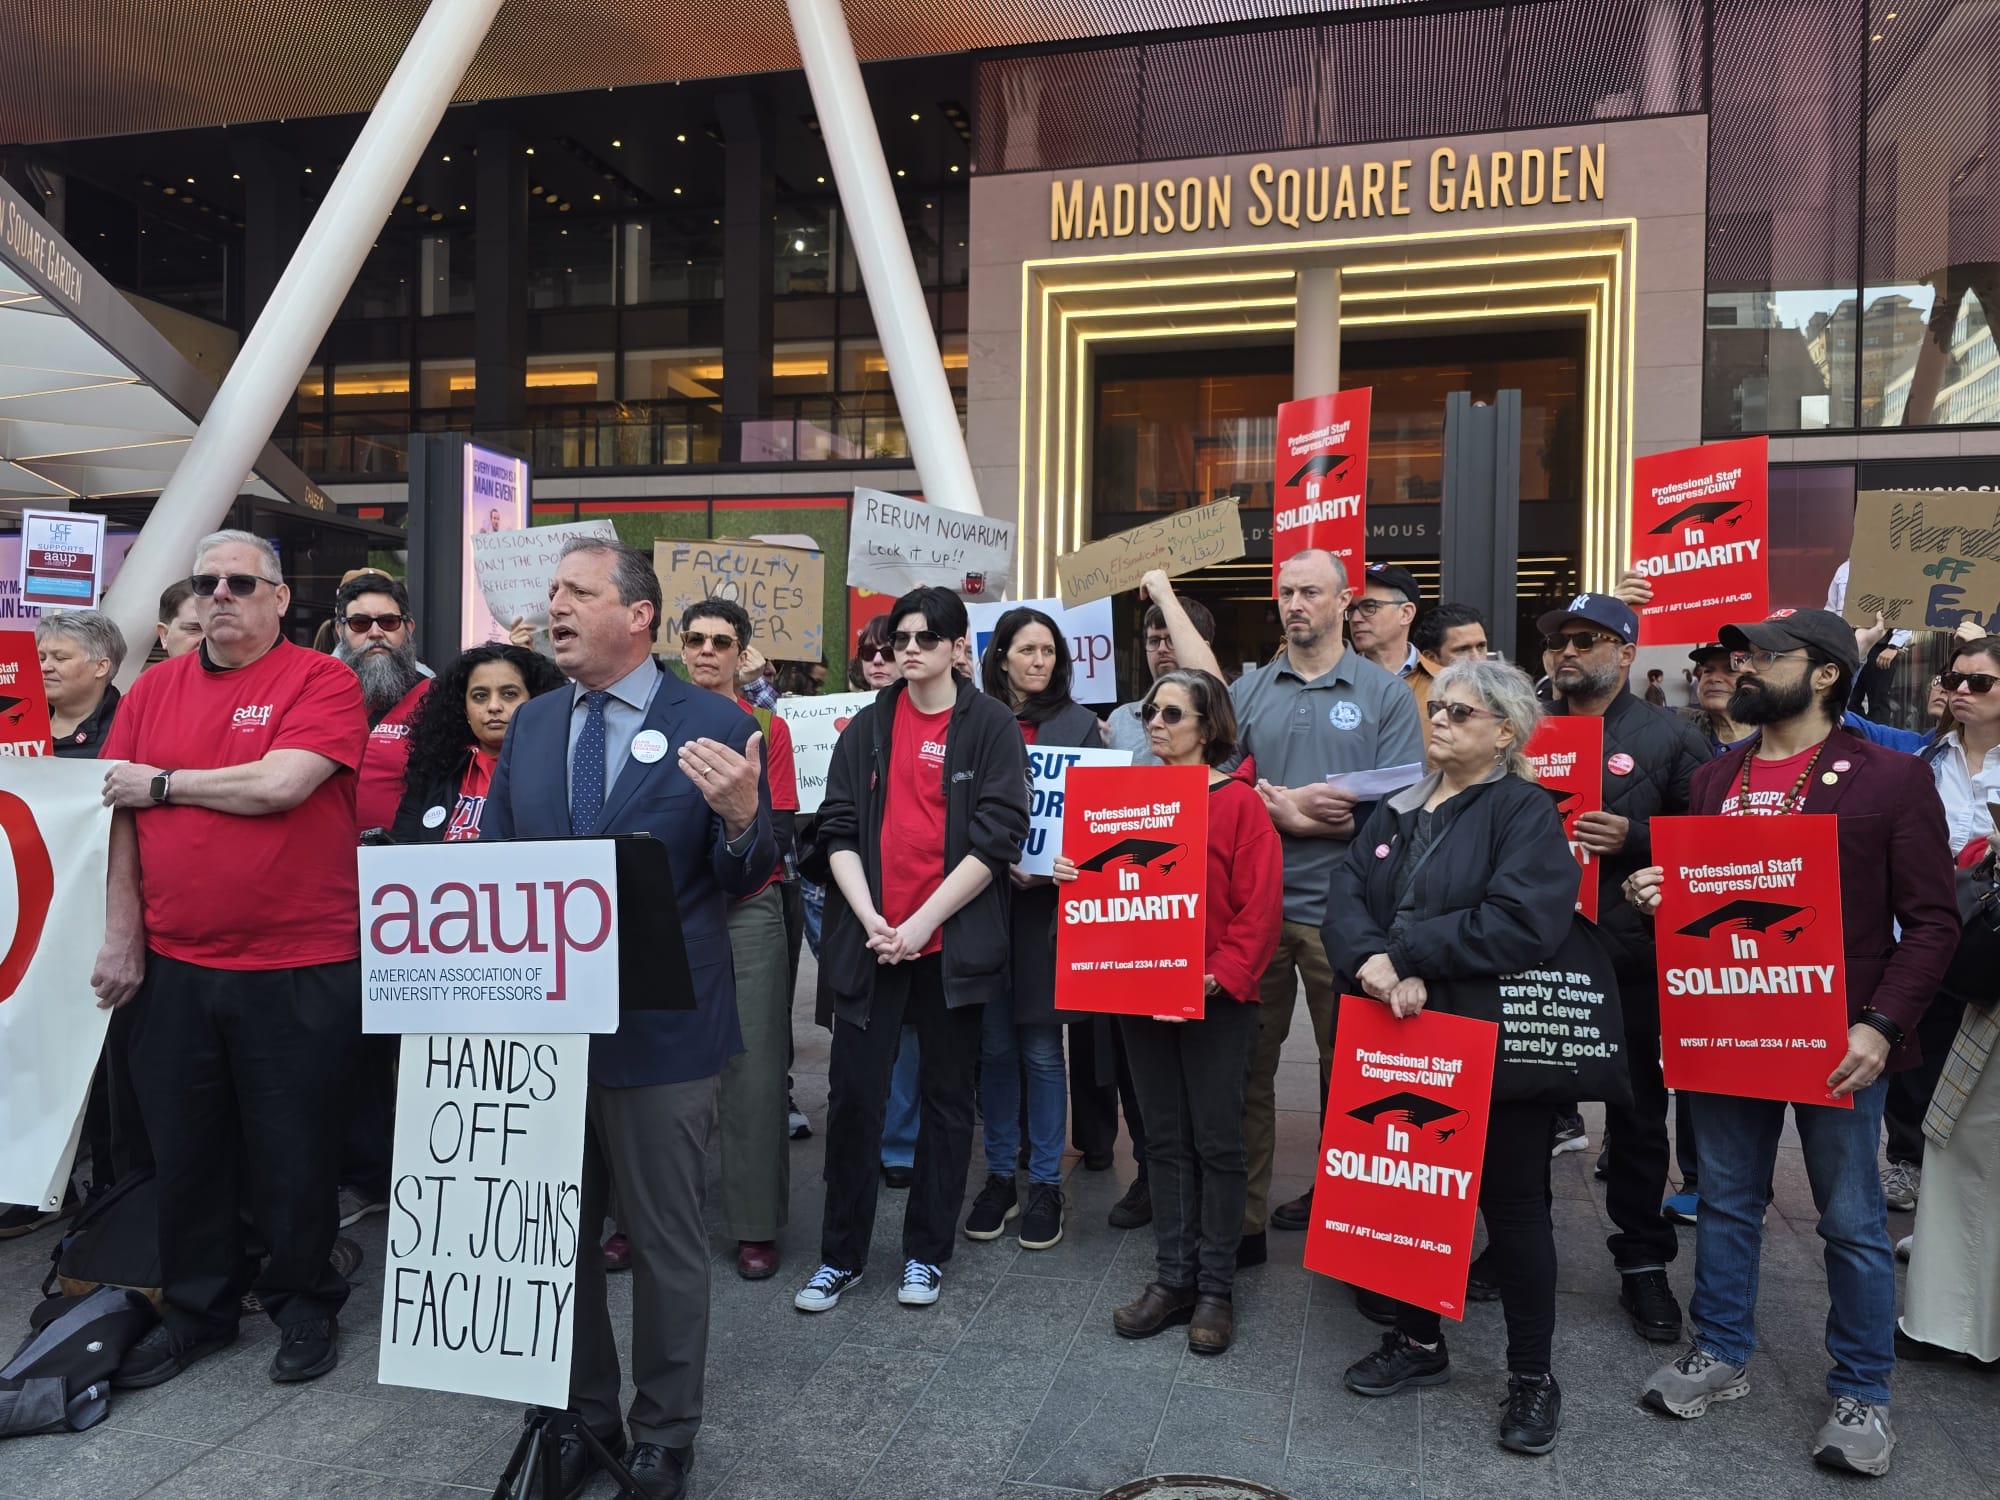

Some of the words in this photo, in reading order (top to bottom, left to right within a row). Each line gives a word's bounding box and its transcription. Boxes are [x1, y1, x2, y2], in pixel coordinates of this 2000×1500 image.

[1288, 423, 1330, 447] Professional
[1331, 420, 1350, 434] Staff
[1291, 432, 1346, 457] Congress/CUNY
[474, 475, 494, 497] MAIN
[495, 482, 517, 504] EVENT
[1306, 481, 1320, 500] In
[1652, 474, 1713, 497] Professional
[1715, 468, 1742, 483] Staff
[1657, 480, 1736, 506] Congress/CUNY
[1276, 495, 1361, 532] SOLIDARITY
[49, 523, 72, 533] UCE
[866, 498, 930, 534] RERUM
[937, 518, 1009, 551] NOVARUM
[474, 535, 543, 550] DECISIONS
[1119, 522, 1164, 552] YES
[1684, 527, 1704, 546] In
[38, 544, 84, 552] SUPPORTS
[1635, 538, 1761, 578] SOLIDARITY
[44, 552, 77, 567] aaup
[476, 557, 505, 573] ONLY
[511, 555, 533, 568] THE
[672, 549, 800, 583] FACULTY
[519, 579, 542, 589] THE
[702, 575, 804, 610] VOICES
[521, 603, 545, 613] THE
[784, 705, 837, 720] FACULTY
[793, 744, 808, 753] OF
[921, 740, 947, 757] aau
[1551, 752, 1576, 764] Staff
[1084, 805, 1150, 822] Professional
[1153, 802, 1180, 815] Staff
[1090, 816, 1175, 834] Congress/CUNY
[1680, 861, 1764, 879] Professional
[1767, 858, 1803, 873] Staff
[1118, 868, 1139, 891] In
[1688, 873, 1796, 894] Congress/CUNY
[1065, 894, 1199, 925] SOLIDARITY
[370, 878, 612, 1001] aaup
[1731, 934, 1758, 959] In
[369, 968, 436, 983] AMERICAN
[439, 967, 522, 982] ASSOCIATION
[525, 967, 542, 981] OF
[1071, 962, 1094, 971] NYSUT
[1100, 961, 1114, 970] AFT
[1115, 960, 1133, 969] Local
[1135, 960, 1153, 969] 2334
[1159, 959, 1187, 968] AFL-CIO
[1566, 972, 1592, 985] are
[1666, 965, 1835, 995] SOLIDARITY
[369, 986, 449, 1001] UNIVERSITY
[453, 986, 543, 1001] PROFESSORS
[1499, 984, 1553, 1001] rarely
[1558, 986, 1605, 1004] clever
[1503, 1001, 1537, 1015] and
[1542, 1002, 1591, 1020] clever
[1504, 1021, 1570, 1036] women
[1574, 1025, 1600, 1039] are
[1504, 1038, 1557, 1056] rarely
[1680, 1038, 1708, 1047] NYSUT
[1717, 1038, 1733, 1047] AFT
[1735, 1038, 1758, 1047] Local
[1760, 1038, 1782, 1048] 2334
[1791, 1038, 1826, 1049] AFL-CIO
[425, 1035, 558, 1101] HANDS
[1356, 1048, 1428, 1070] Professional
[1431, 1057, 1463, 1073] Staff
[1361, 1063, 1455, 1088] Congress/CUNY
[429, 1101, 530, 1166] OFF
[1386, 1124, 1409, 1153] In
[1325, 1148, 1473, 1200] SOLIDARITY
[390, 1174, 457, 1258] ST.
[469, 1176, 579, 1268] JOHN'S
[1325, 1219, 1350, 1233] NYSUT
[1356, 1226, 1371, 1238] AFT
[1372, 1229, 1392, 1242] Local
[1393, 1233, 1413, 1247] 2334
[1420, 1240, 1451, 1255] AFL-CIO
[392, 1267, 573, 1362] FACULTY
